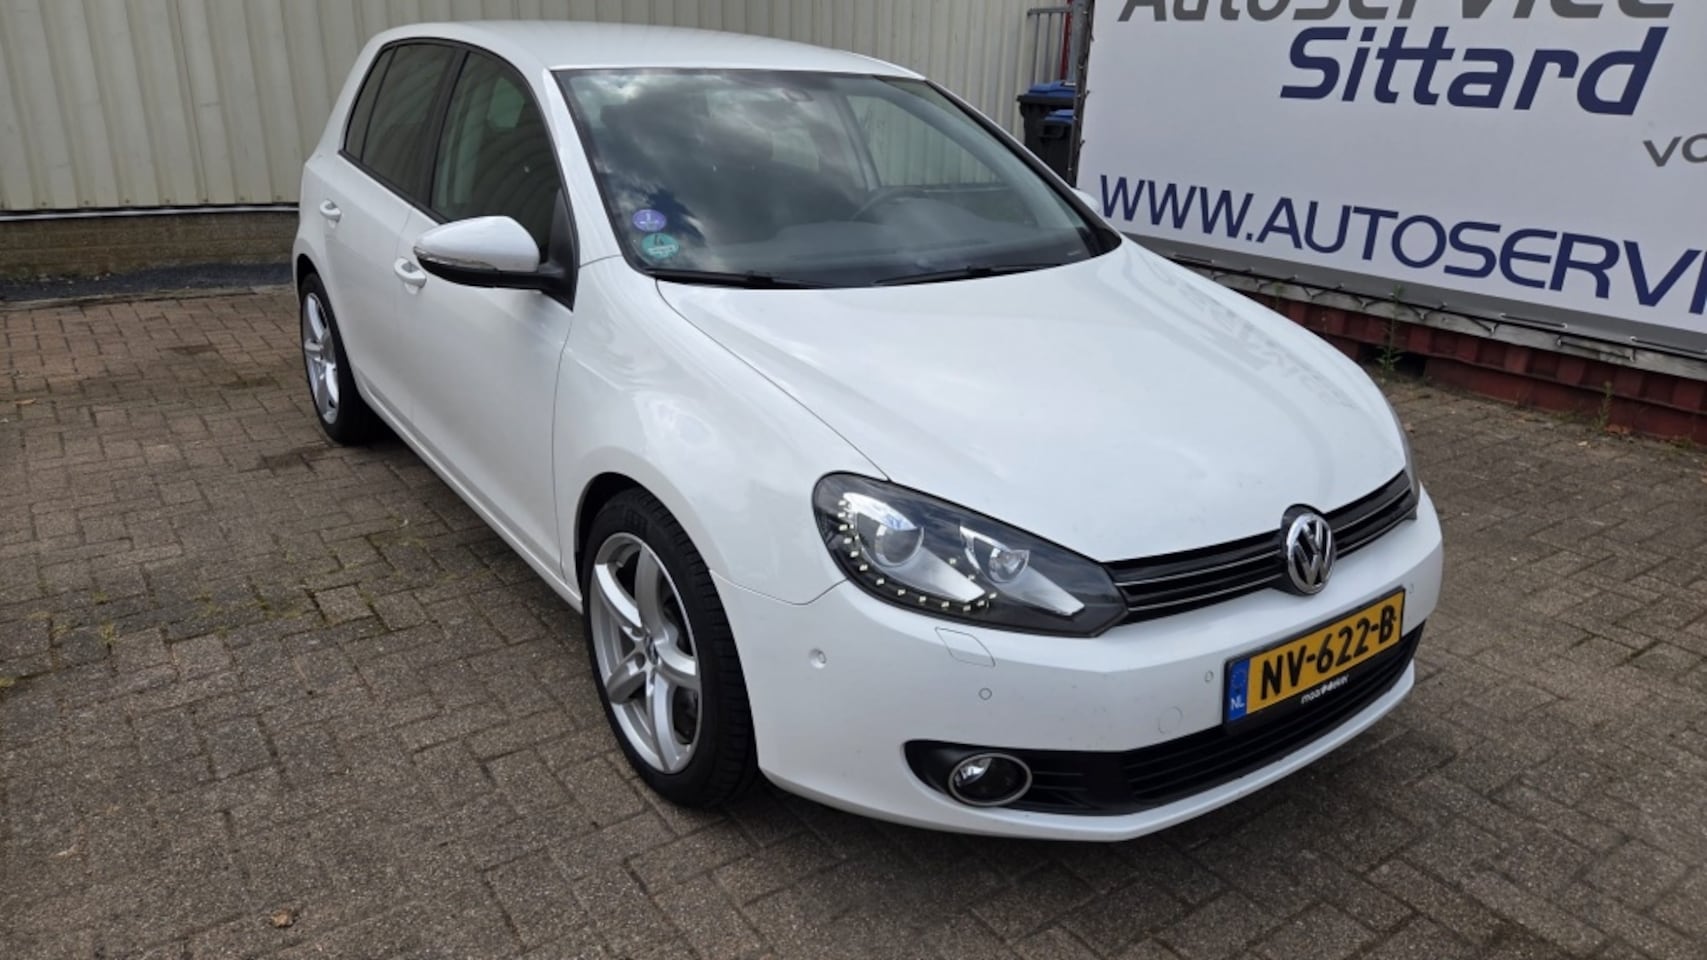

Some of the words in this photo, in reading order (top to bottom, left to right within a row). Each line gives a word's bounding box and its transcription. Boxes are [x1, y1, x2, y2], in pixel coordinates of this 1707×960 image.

[1280, 26, 1668, 116] Sittard
[1261, 604, 1397, 700] NV-622-B
[1230, 696, 1246, 711] NL
